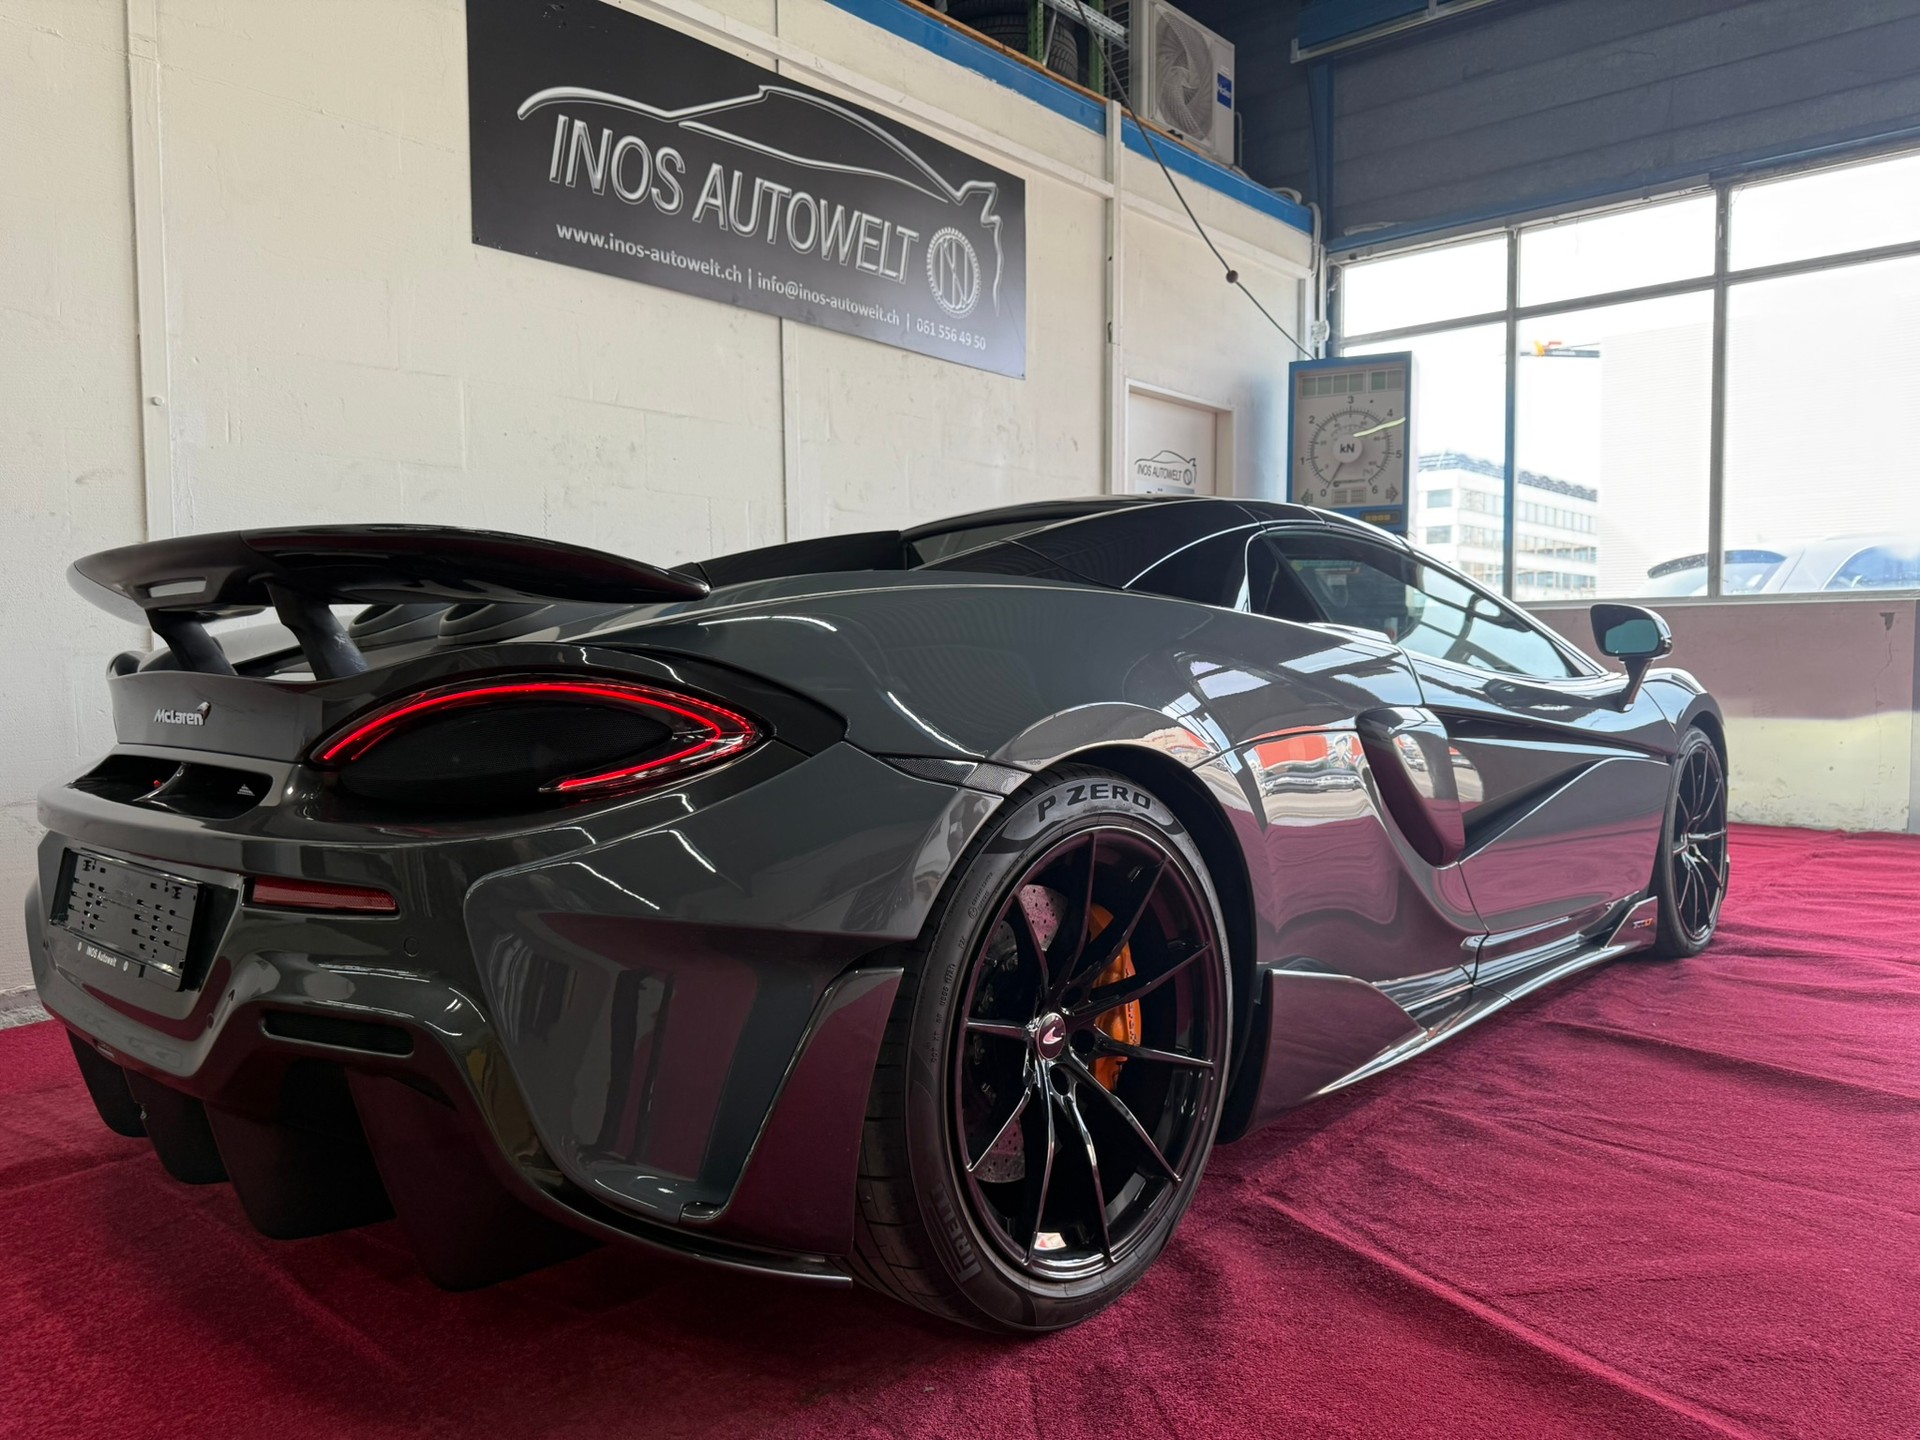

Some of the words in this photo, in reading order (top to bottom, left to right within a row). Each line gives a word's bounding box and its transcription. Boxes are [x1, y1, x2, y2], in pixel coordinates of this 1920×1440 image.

[549, 114, 686, 215] INOS
[692, 163, 919, 285] AUTOWELT
[556, 223, 742, 284] www.inos-autowelt.ch
[757, 272, 900, 326] info@inos-autowelt.ch
[916, 318, 936, 336] 061
[938, 324, 957, 342] 556
[959, 330, 972, 346] 49
[973, 335, 986, 350] 50
[1347, 395, 1354, 404] 3
[1386, 408, 1393, 417] 4
[1308, 416, 1315, 424] 2
[1339, 443, 1355, 454] kN
[1396, 450, 1402, 459] 5
[1137, 463, 1152, 477] INOS
[1152, 466, 1182, 481] AUTOWELT
[1320, 489, 1327, 497] 0
[1371, 486, 1378, 495] 6
[154, 708, 204, 726] McLaren
[1037, 795, 1057, 822] P
[1066, 783, 1151, 810] ZERO
